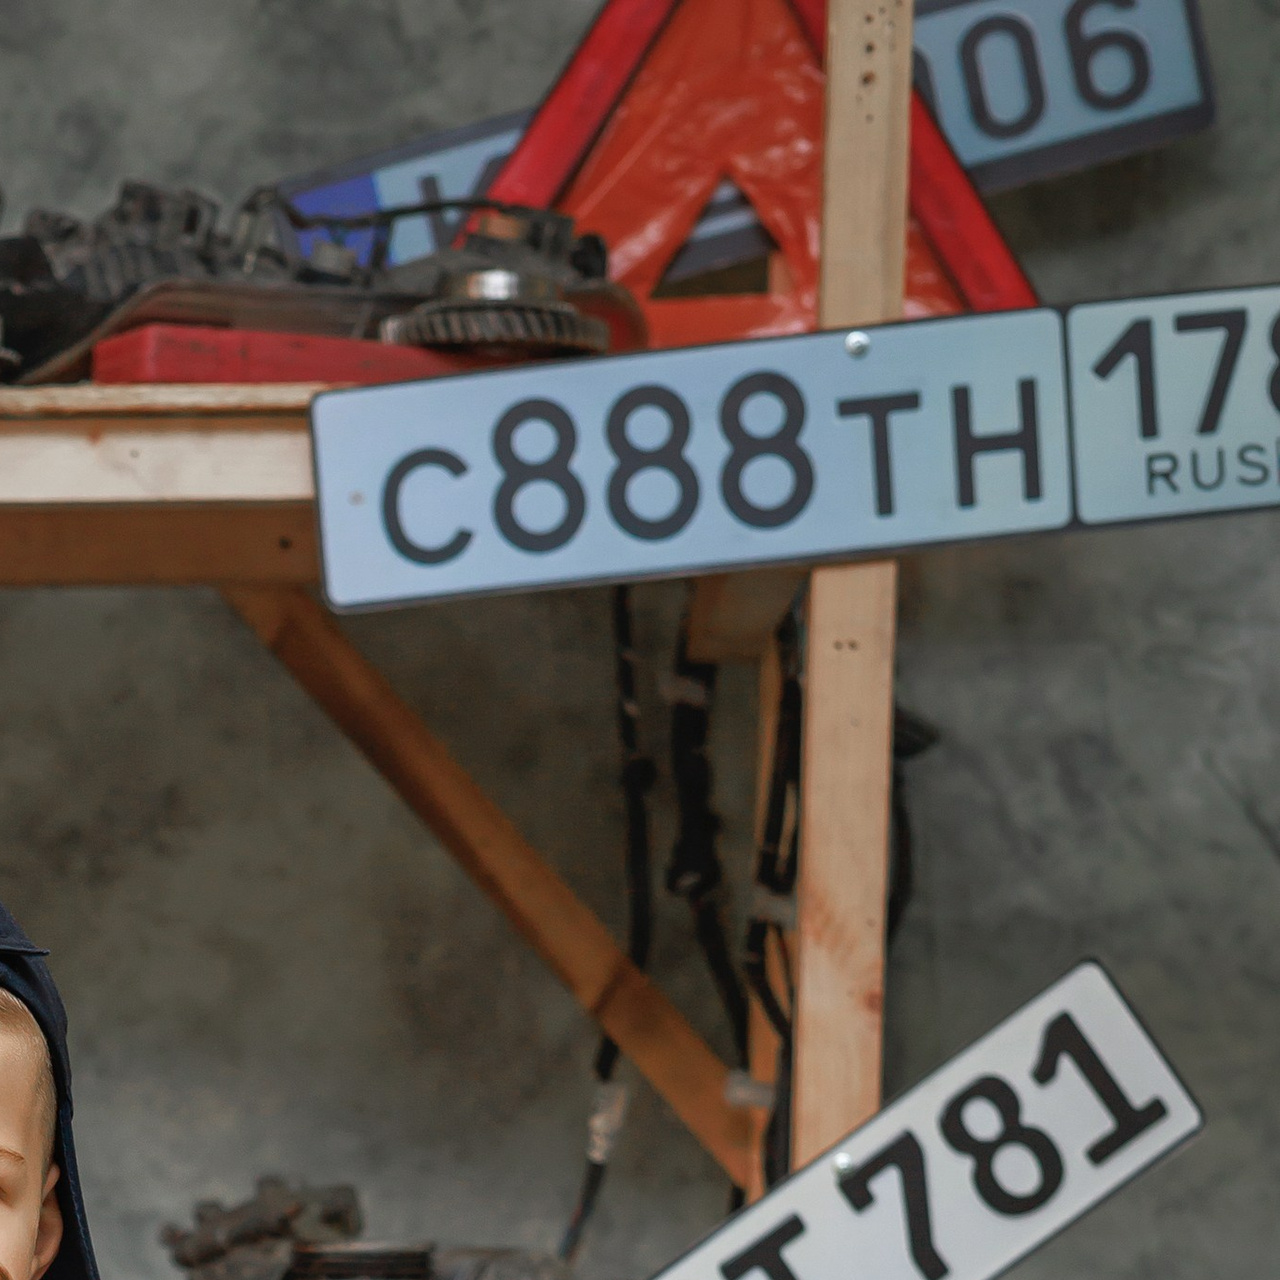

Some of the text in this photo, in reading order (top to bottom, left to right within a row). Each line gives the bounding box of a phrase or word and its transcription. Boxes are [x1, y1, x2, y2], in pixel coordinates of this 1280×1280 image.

[913, 0, 1151, 139] 06
[1093, 308, 1280, 438] 17
[1146, 443, 1270, 496] RUS
